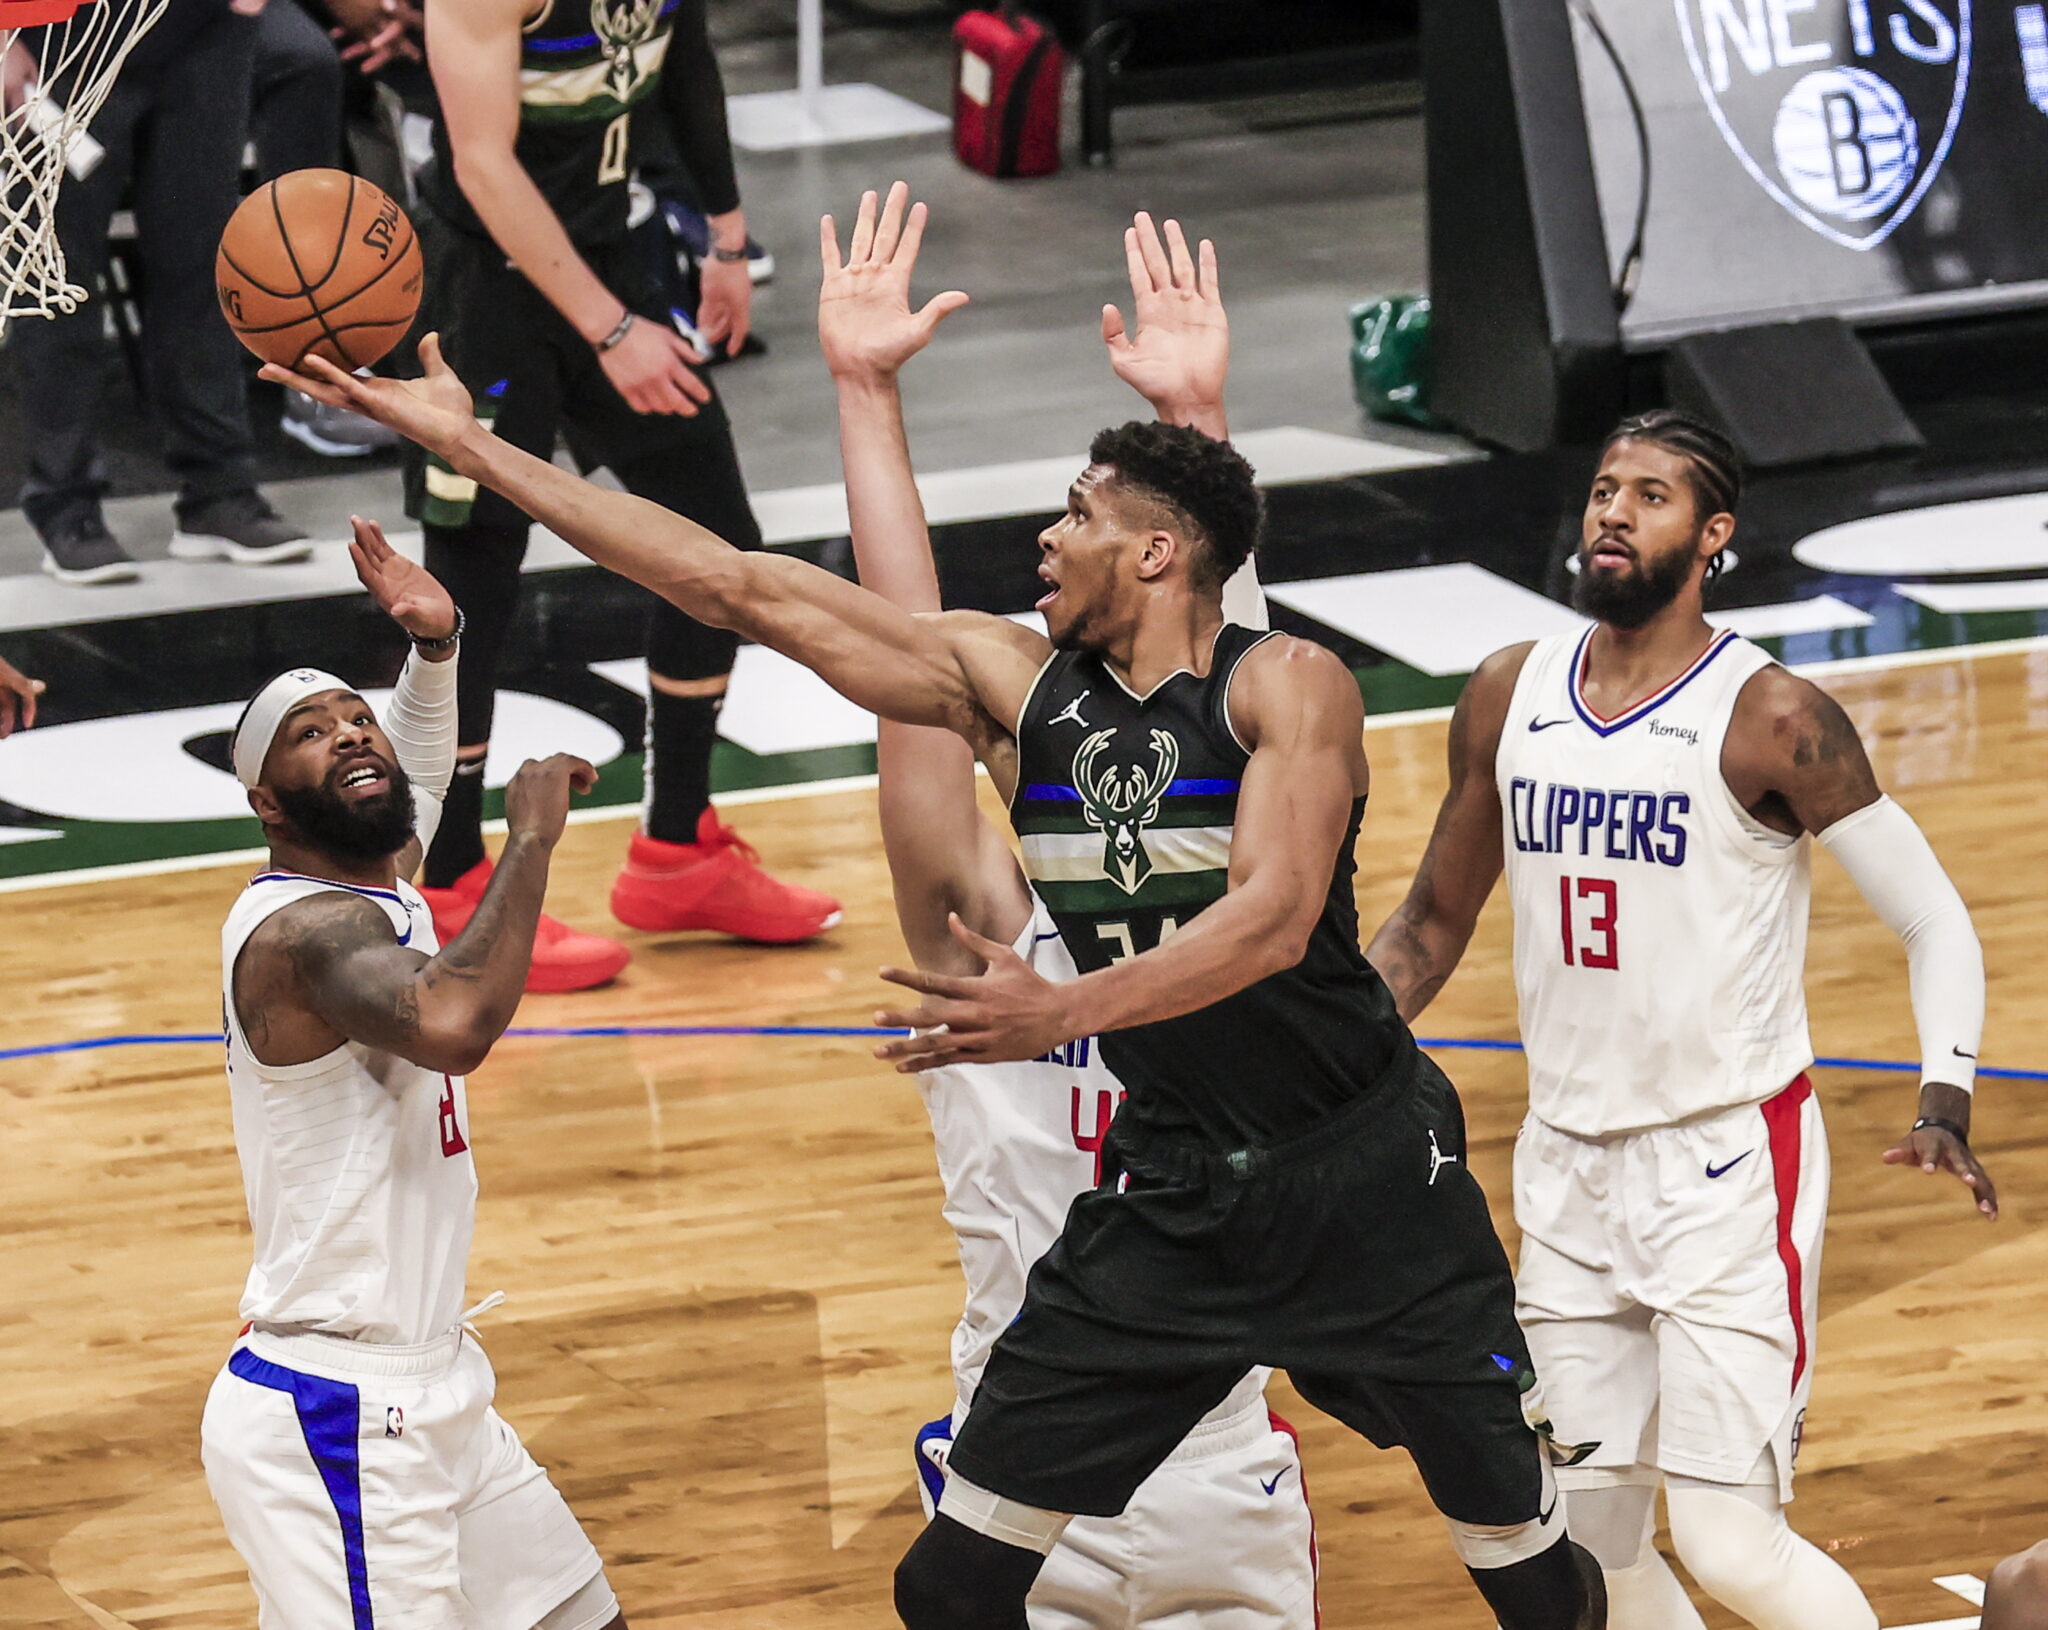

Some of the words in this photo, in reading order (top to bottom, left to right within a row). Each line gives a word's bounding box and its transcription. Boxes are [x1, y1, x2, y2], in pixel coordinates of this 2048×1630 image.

[1648, 718, 1699, 746] honey
[1511, 775, 1690, 868] CLIPPERS
[1560, 875, 1620, 971] 13
[1071, 1085, 1129, 1188] 4
